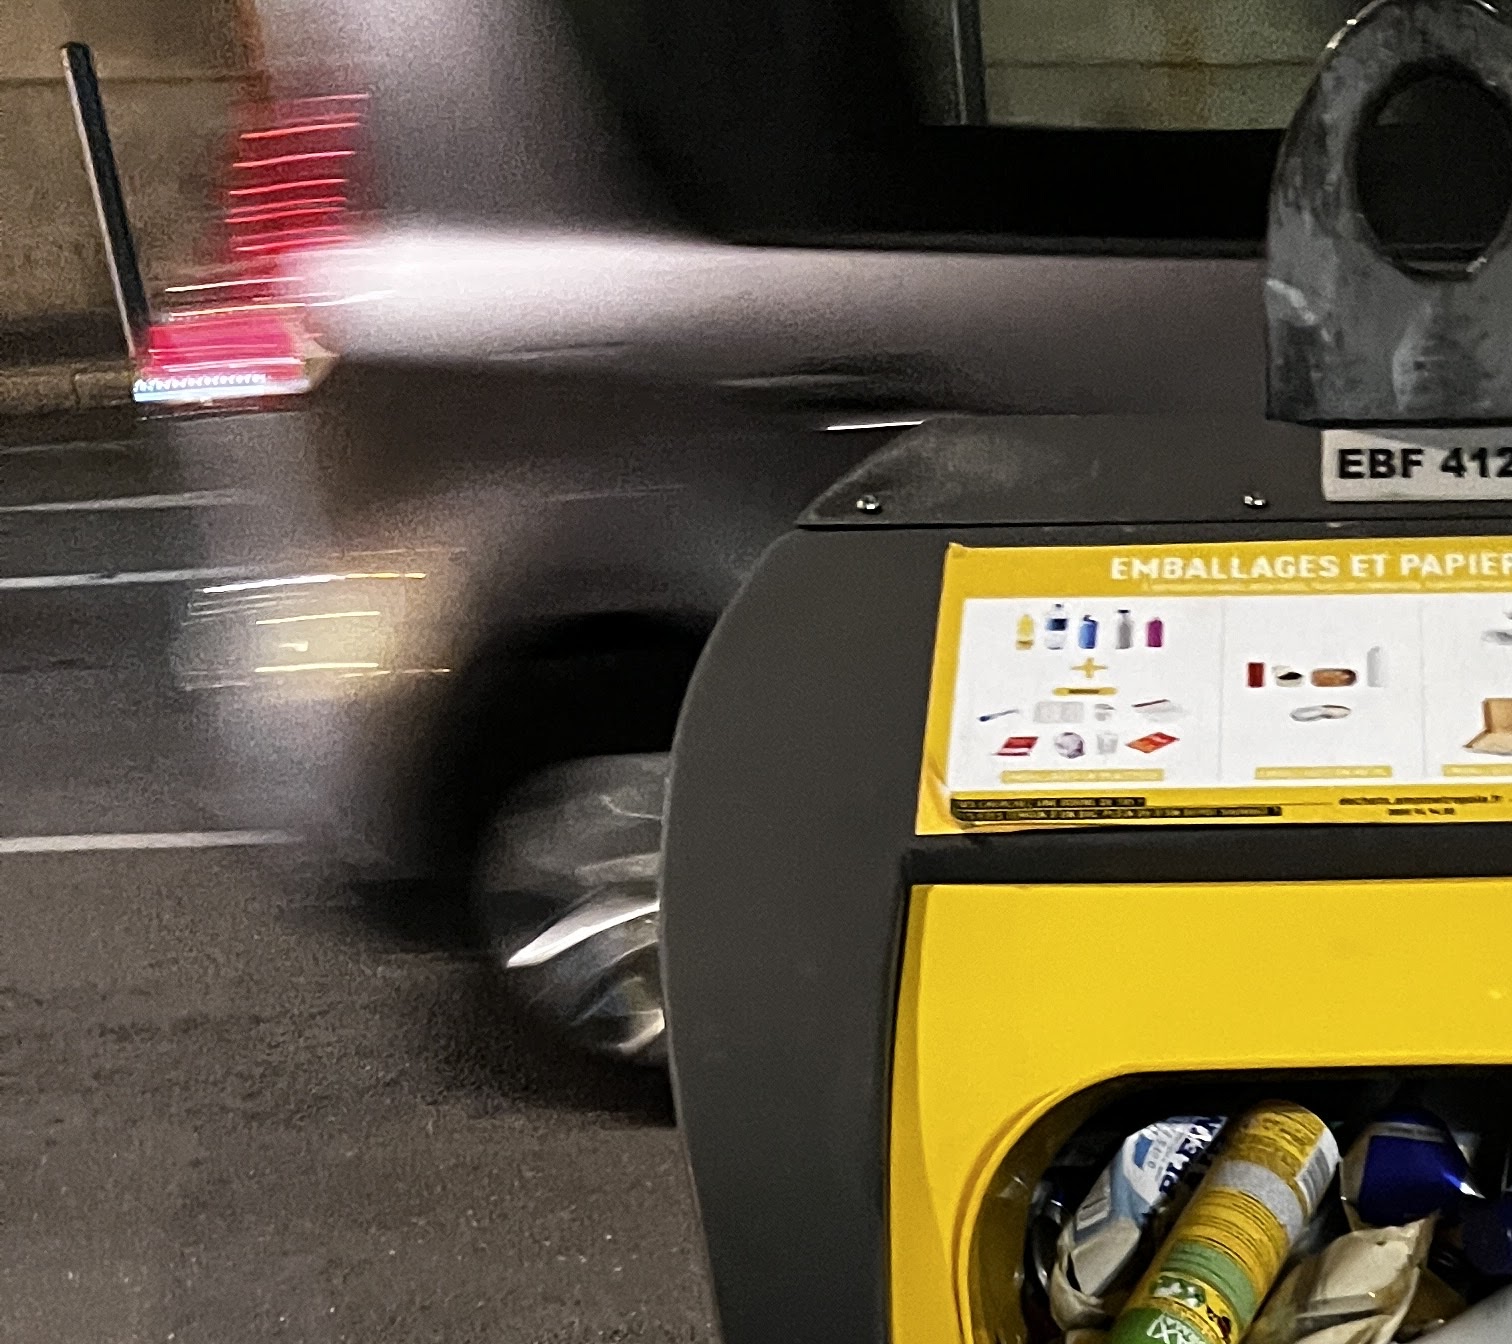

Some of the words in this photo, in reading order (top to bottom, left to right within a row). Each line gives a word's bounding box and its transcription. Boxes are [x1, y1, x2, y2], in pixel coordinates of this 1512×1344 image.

[1338, 448, 1425, 479] EBF
[1110, 553, 1340, 580] EMBALLAGES
[1350, 552, 1390, 578] ET
